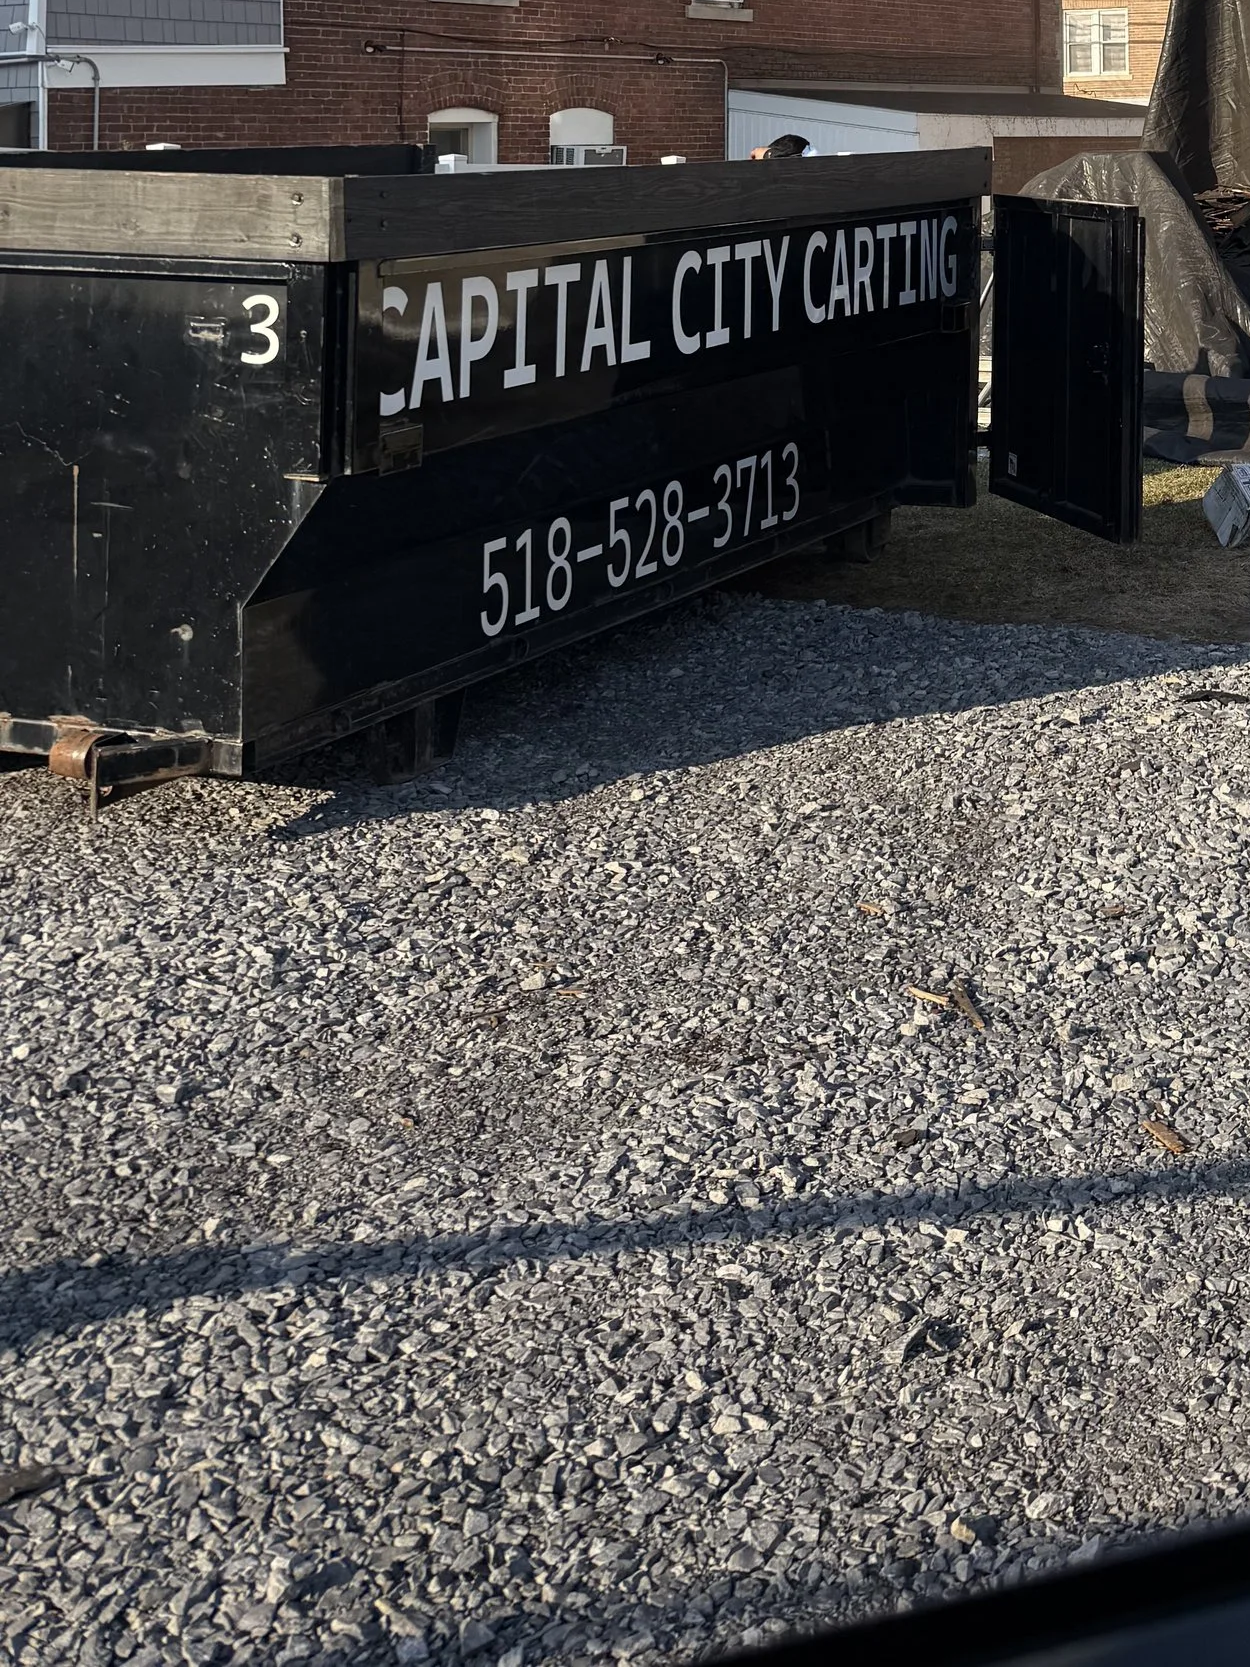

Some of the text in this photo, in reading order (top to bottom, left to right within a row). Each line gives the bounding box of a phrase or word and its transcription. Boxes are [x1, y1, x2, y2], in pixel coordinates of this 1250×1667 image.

[240, 294, 280, 365] 3
[673, 236, 790, 355] CITY
[803, 215, 958, 324] CARTING
[480, 442, 801, 637] 518-528-3713
